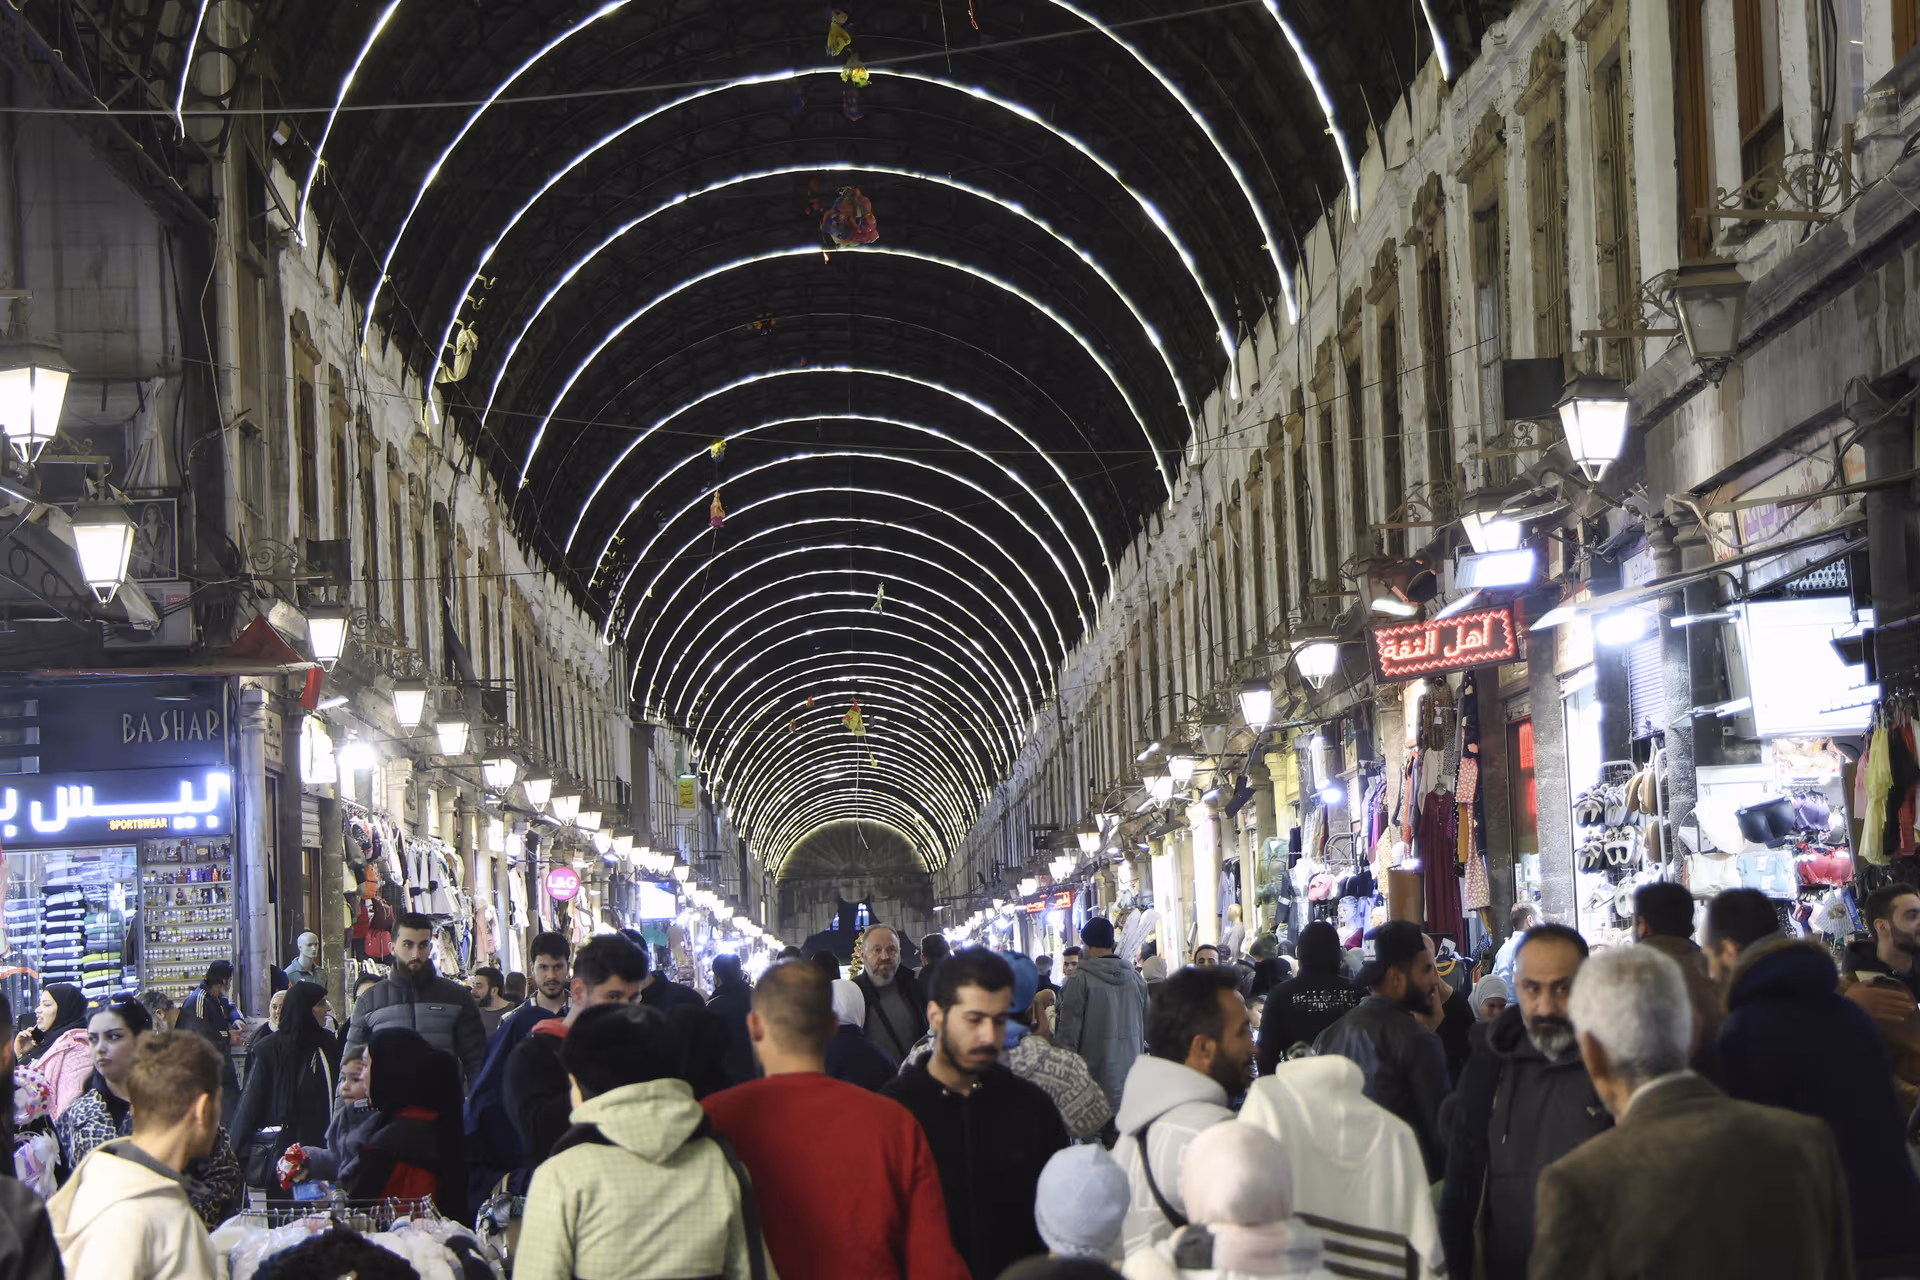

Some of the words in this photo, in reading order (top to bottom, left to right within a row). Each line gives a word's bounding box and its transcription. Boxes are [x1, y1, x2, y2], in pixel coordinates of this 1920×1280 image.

[1383, 630, 1436, 660] الثقة
[122, 709, 220, 744] BASHAR
[109, 817, 168, 831] SPORTSWEAR
[548, 875, 577, 889] L&G
